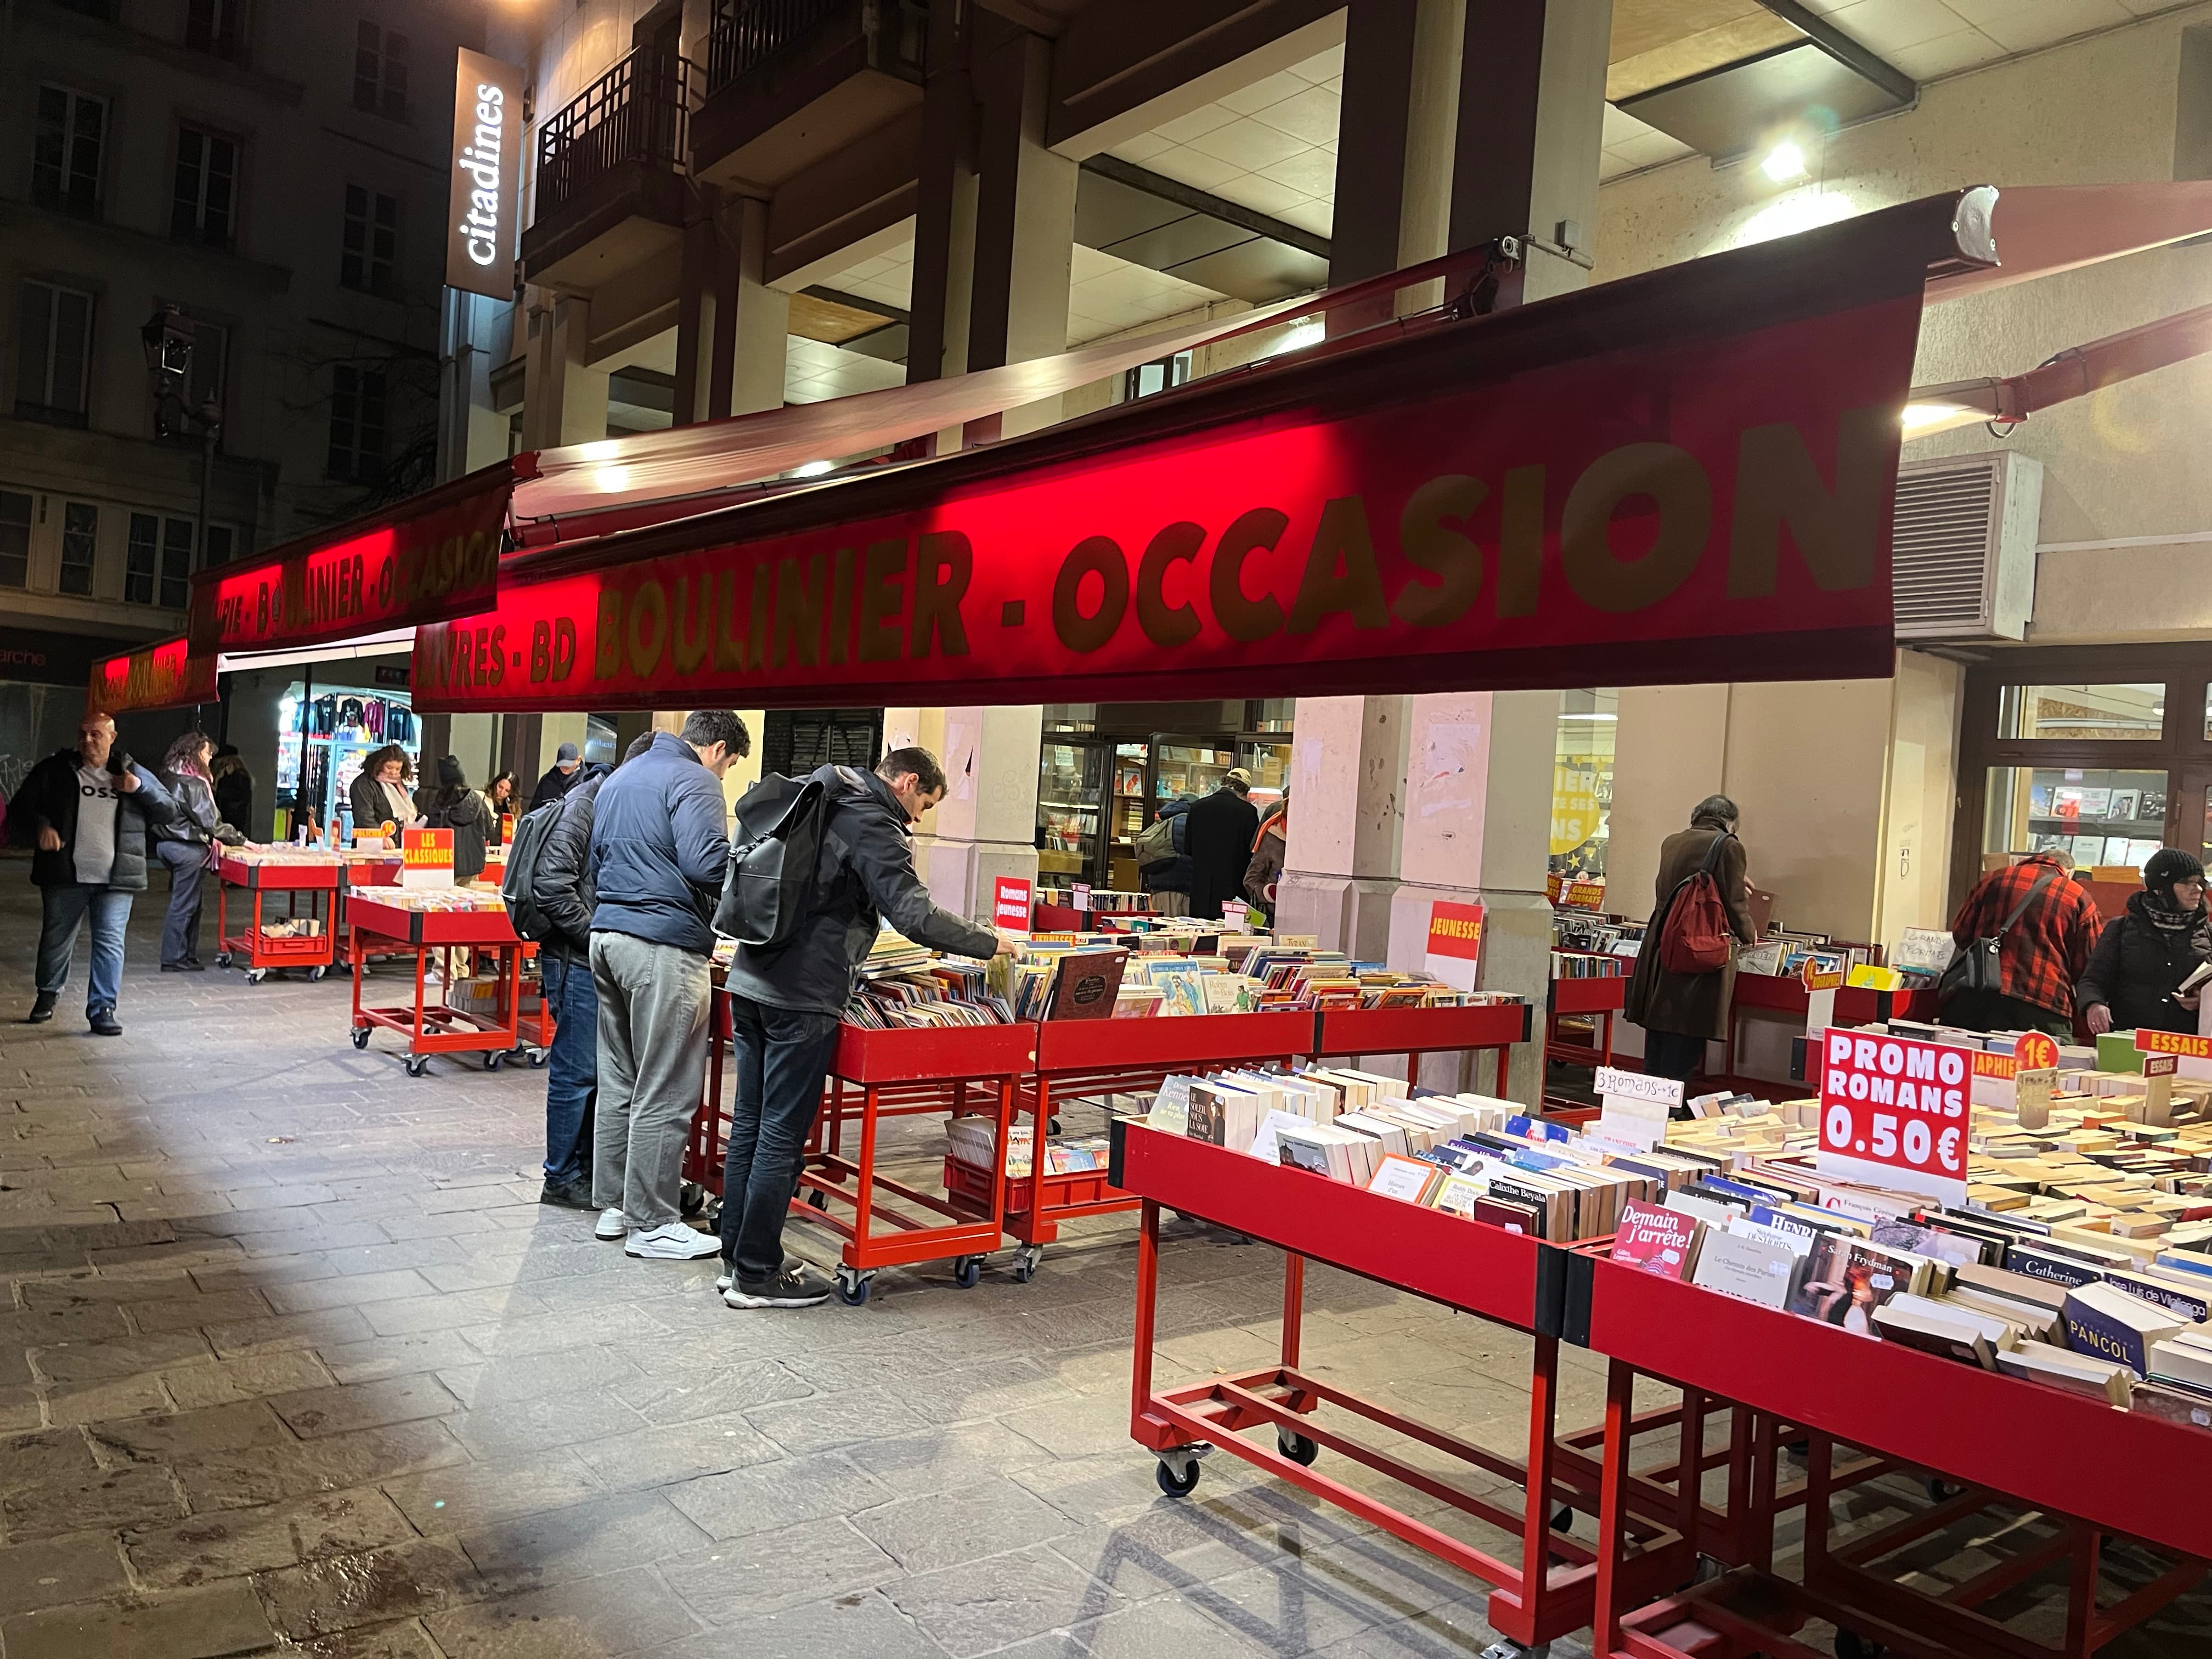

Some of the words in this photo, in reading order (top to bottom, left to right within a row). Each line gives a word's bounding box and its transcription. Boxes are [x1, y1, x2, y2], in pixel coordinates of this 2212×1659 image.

[460, 83, 504, 267] citadines
[530, 617, 577, 683] BD
[594, 530, 972, 680] BOULINIER
[1052, 404, 1888, 653] OCCASION
[421, 832, 436, 848] LES
[404, 849, 453, 864] CLASSIQUES
[1000, 885, 1028, 902] Romans
[1567, 893, 1602, 905] FORMATS
[1572, 885, 1602, 896] GRANDS
[1430, 917, 1481, 941] JEUNESSE
[2024, 1037, 2051, 1069] 1€
[2151, 1033, 2209, 1057] ESSAIS
[1830, 1035, 1964, 1086] PROMO
[1976, 1054, 2023, 1079] APHIES
[2150, 1058, 2174, 1074] ESSAIS
[1597, 1072, 1605, 1088] 3
[1607, 1074, 1658, 1096] Romans
[1827, 1069, 1963, 1118] ROMANS
[1189, 1102, 1206, 1115] SOLEIL
[1190, 1092, 1197, 1103] LE
[1189, 1111, 1203, 1123] SOUS
[1489, 1180, 1520, 1197] Calixthe
[1520, 1187, 1547, 1203] Beyala
[1621, 1205, 1679, 1231] Demain
[1770, 1214, 1818, 1239] HENRI
[1854, 1252, 1893, 1273] Frydman
[2025, 1260, 2083, 1285] Catherine
[2145, 1289, 2159, 1302] de
[2070, 1320, 2133, 1364] PANCOL
